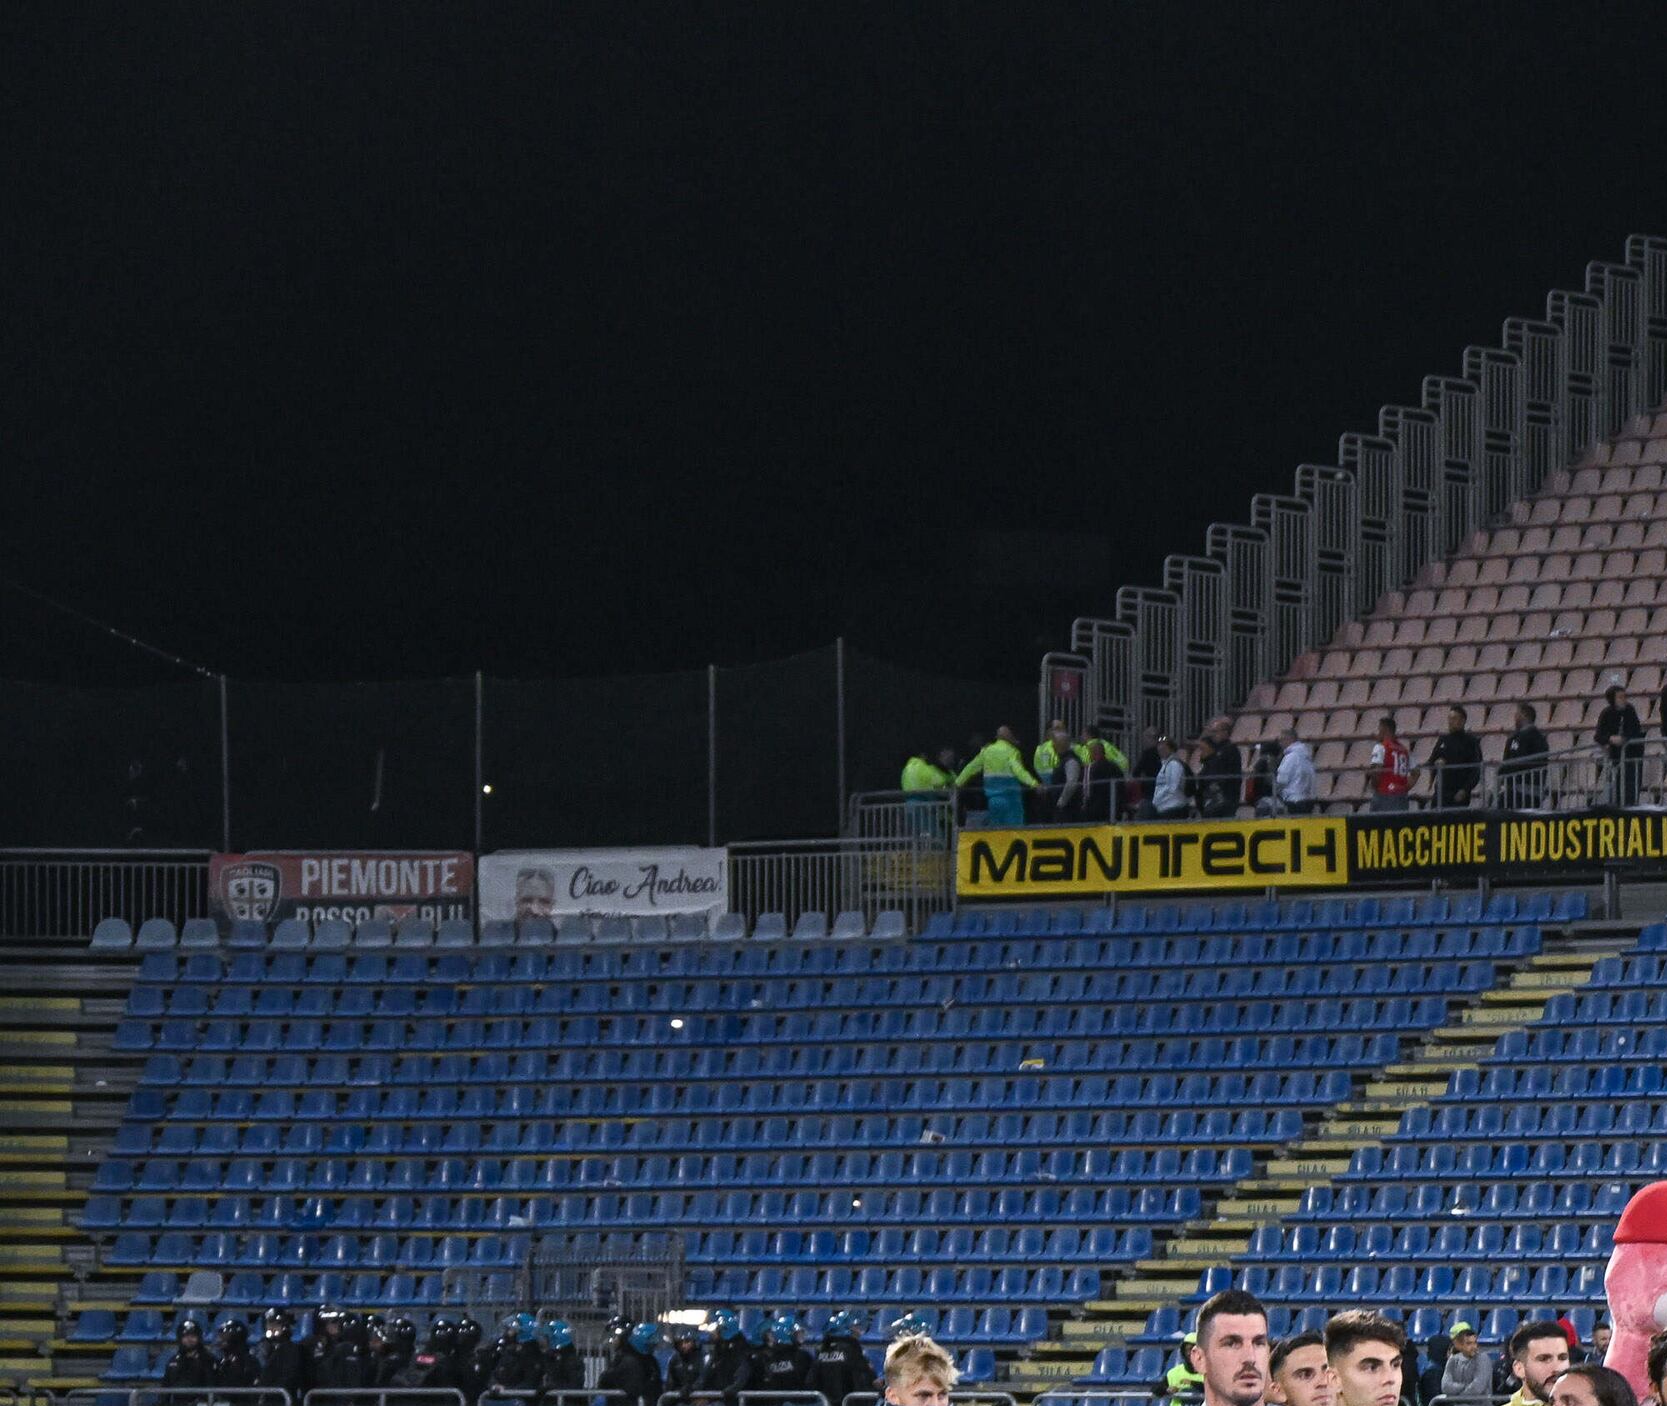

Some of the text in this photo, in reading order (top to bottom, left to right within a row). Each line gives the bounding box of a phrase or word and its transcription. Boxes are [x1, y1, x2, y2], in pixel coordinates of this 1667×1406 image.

[1356, 820, 1486, 870] MACCHINE
[300, 857, 459, 896] PIEMONTE
[569, 866, 619, 900] Ciao
